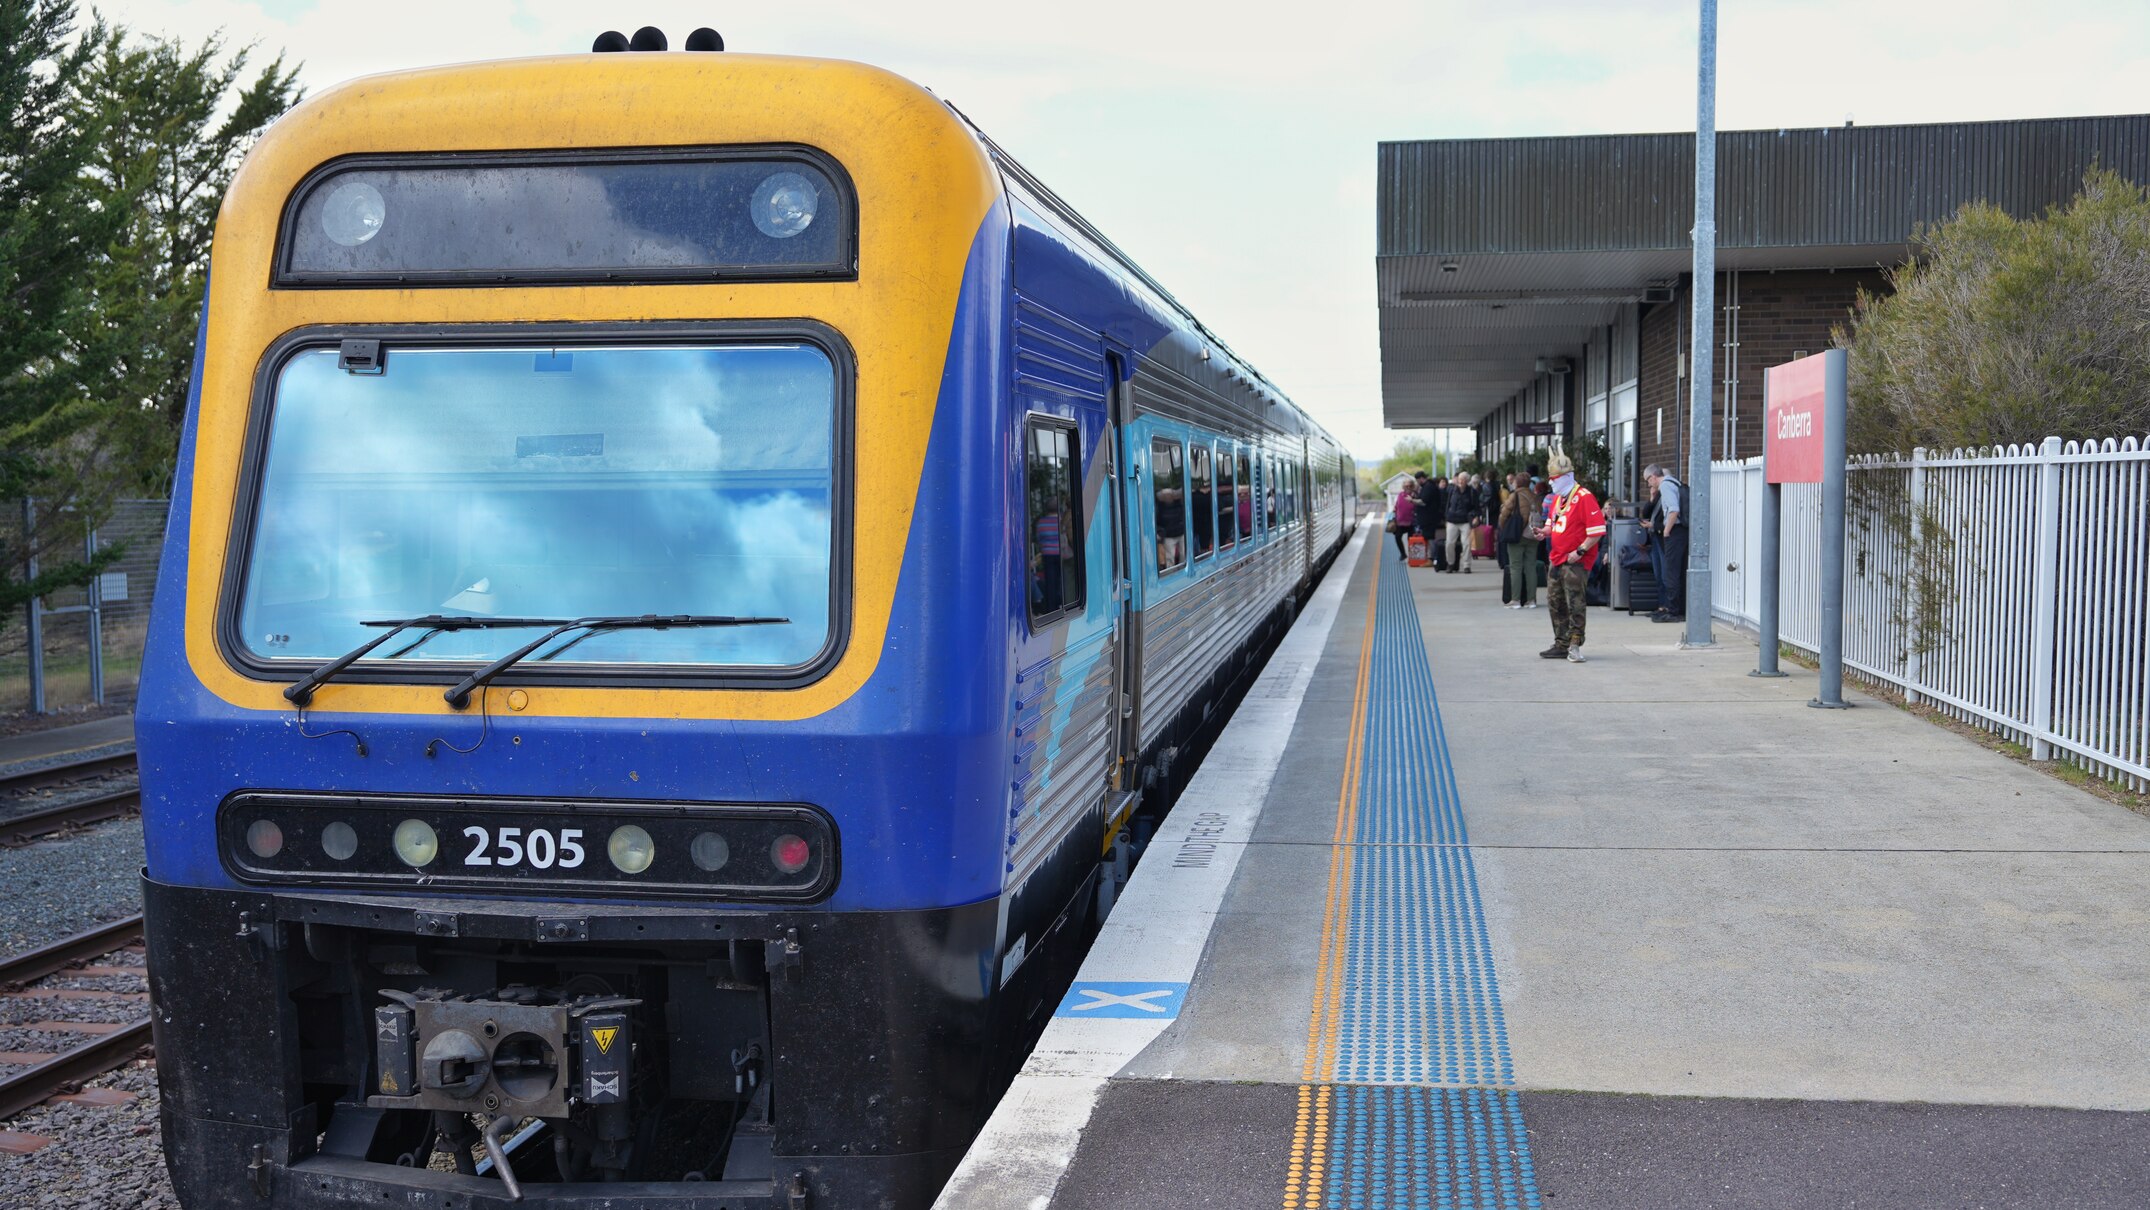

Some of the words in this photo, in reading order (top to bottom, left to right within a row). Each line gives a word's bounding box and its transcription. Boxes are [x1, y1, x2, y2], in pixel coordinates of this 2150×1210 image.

[1777, 406, 1812, 440] Canberra
[1194, 812, 1230, 826] GAP
[463, 825, 585, 869] 2505
[1184, 827, 1225, 843] THE
[1172, 843, 1217, 868] MIND
